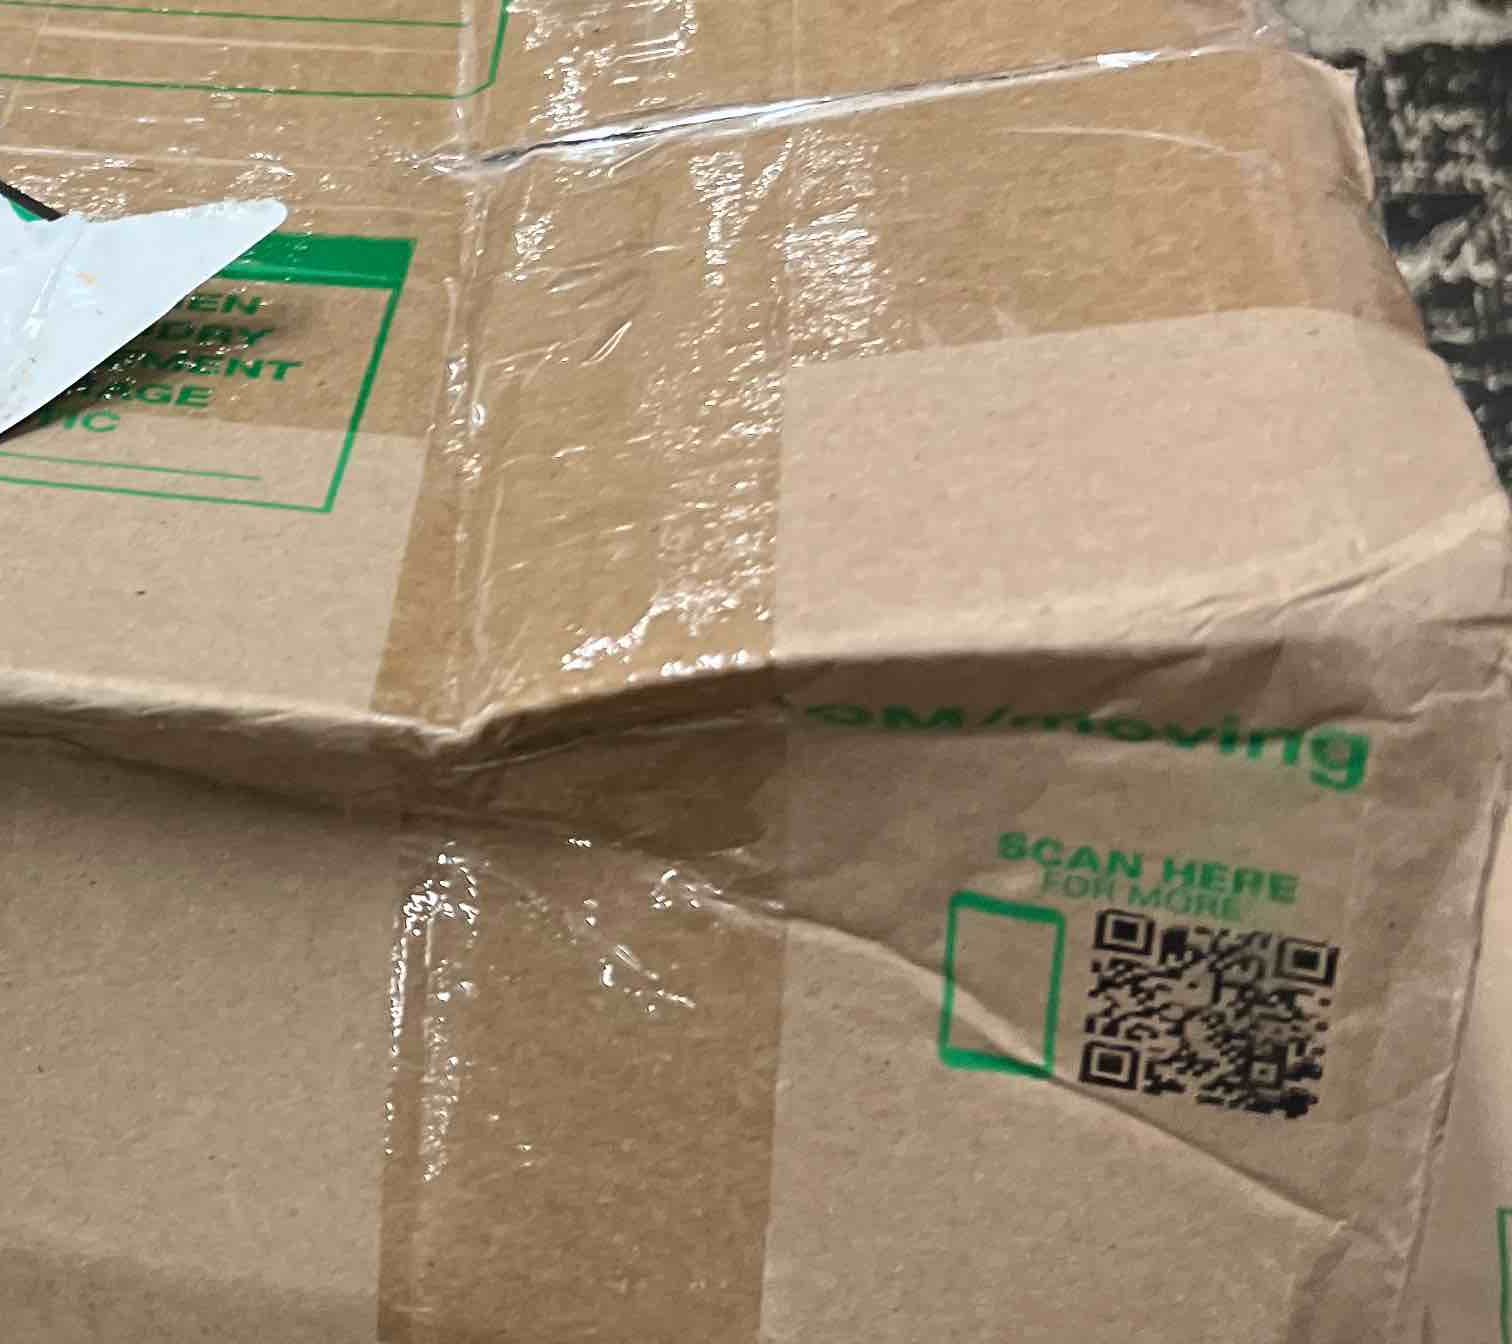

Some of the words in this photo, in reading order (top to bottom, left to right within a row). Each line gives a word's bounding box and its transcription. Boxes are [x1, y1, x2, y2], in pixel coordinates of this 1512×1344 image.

[996, 829, 1145, 881] SCAN
[1162, 854, 1302, 906] HERE
[1039, 867, 1119, 903] FOR
[1127, 879, 1245, 924] MORE
